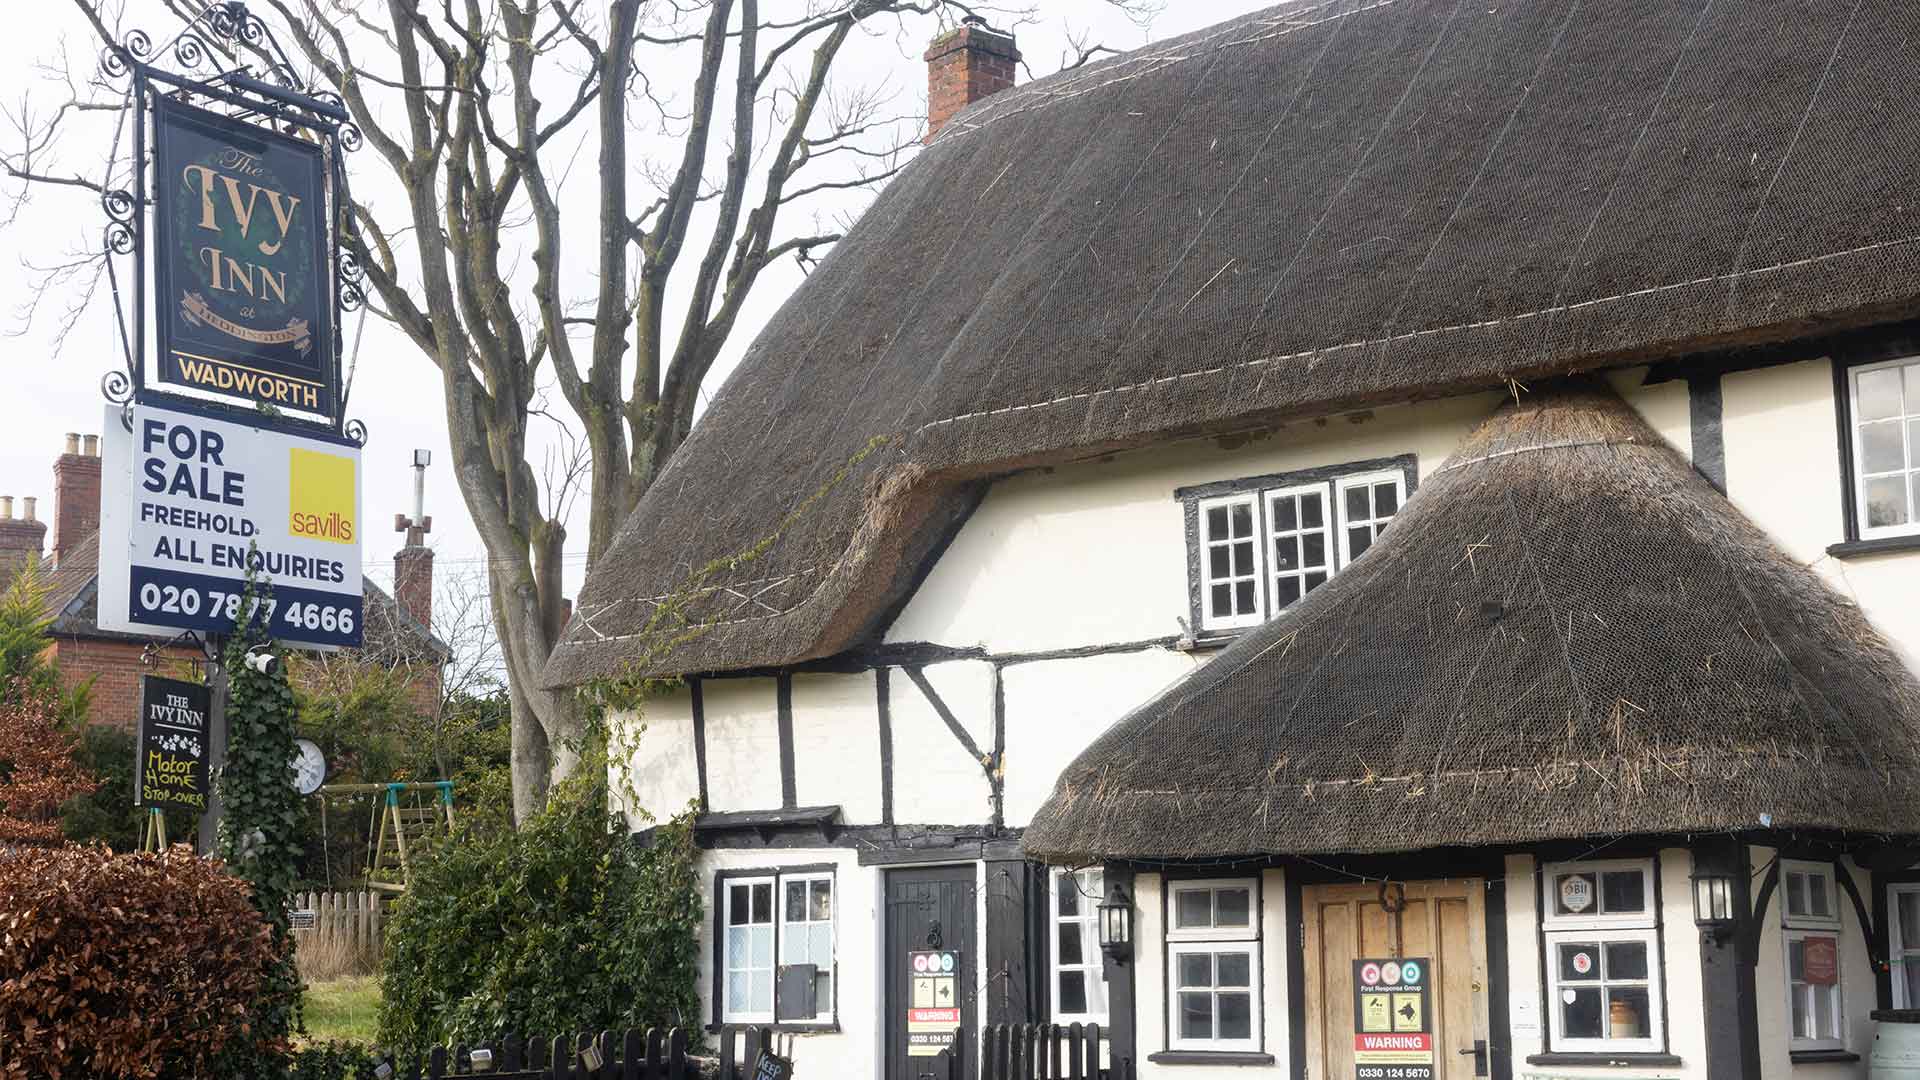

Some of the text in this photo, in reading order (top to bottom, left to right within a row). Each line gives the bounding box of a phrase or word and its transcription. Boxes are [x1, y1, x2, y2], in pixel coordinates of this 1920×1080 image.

[219, 146, 265, 176] The
[200, 247, 287, 304] INN
[240, 306, 256, 318] at
[177, 357, 318, 409] WADWORTH
[143, 418, 224, 467] FOR
[142, 457, 245, 507] SALE
[141, 502, 255, 537] FREEHOLD
[292, 512, 352, 541] savills
[153, 535, 344, 584] ALL ENQUIRIES
[140, 583, 354, 635] 020 7877 4666
[151, 704, 204, 727] IVY INN
[166, 694, 189, 709] THE
[149, 750, 199, 773] Motor
[942, 1035, 954, 1043] 567
[1364, 1037, 1422, 1049] WARNING
[1360, 1068, 1430, 1077] 0330 124 5670
